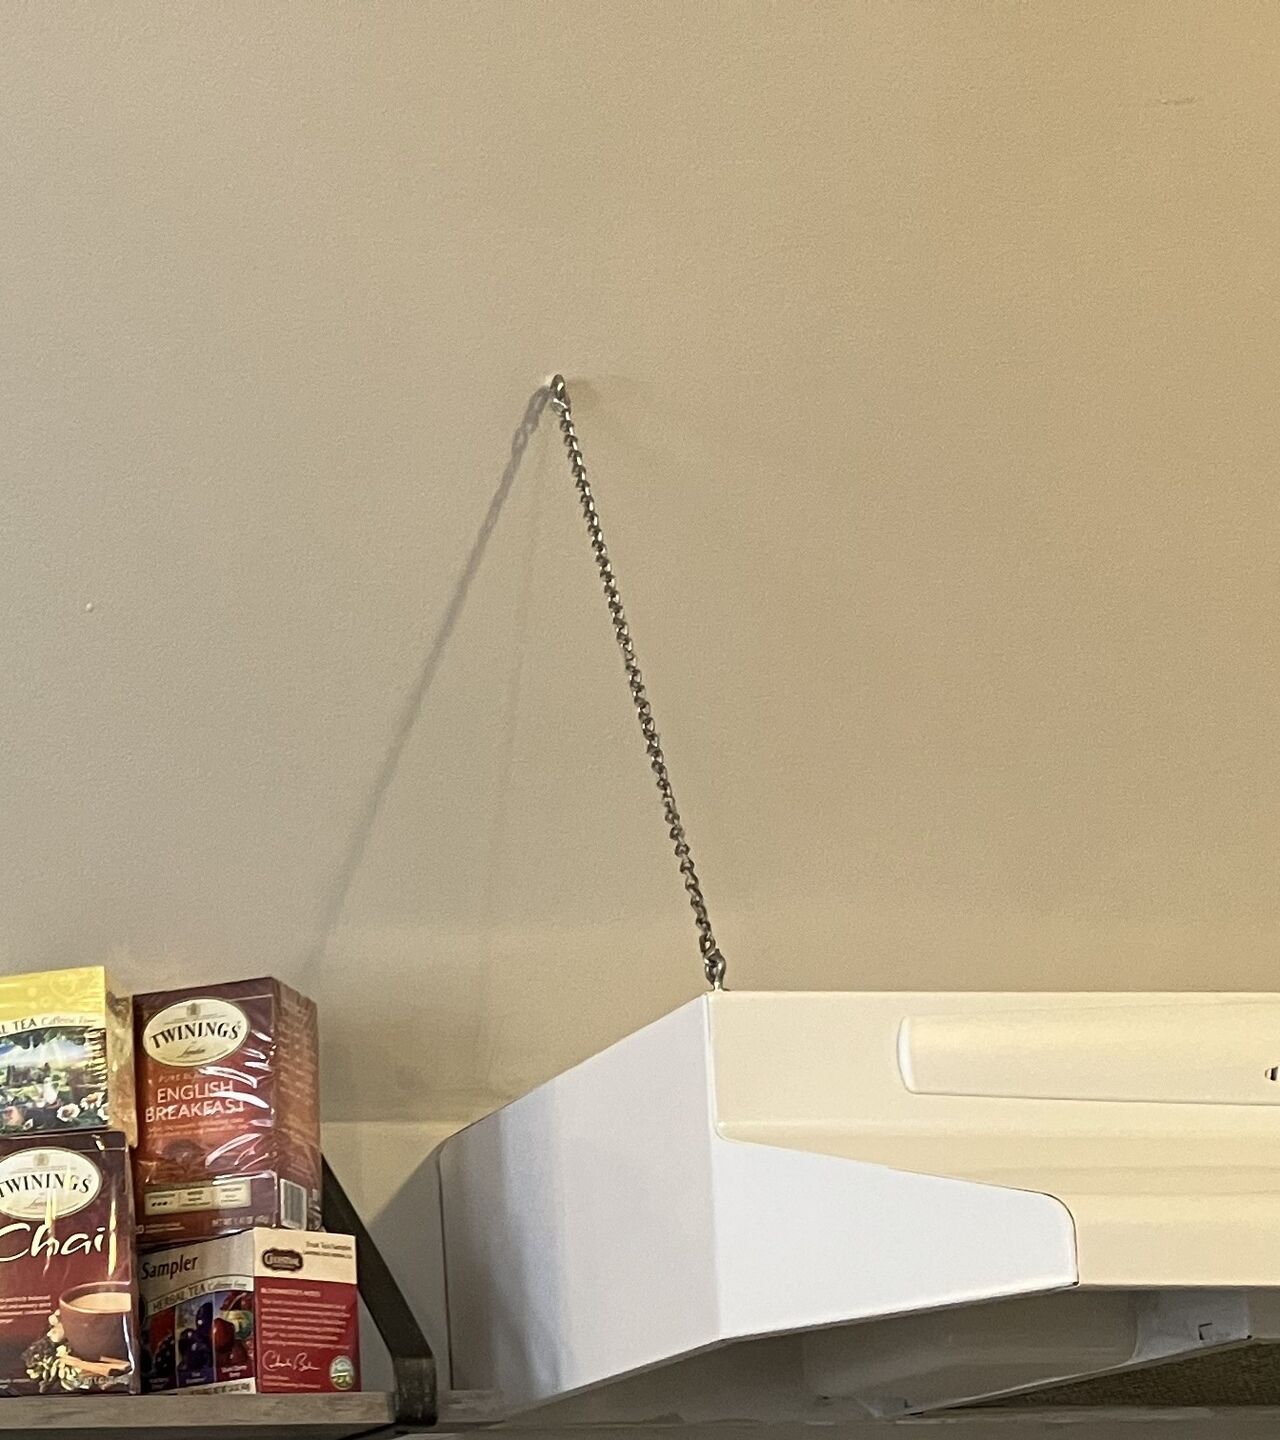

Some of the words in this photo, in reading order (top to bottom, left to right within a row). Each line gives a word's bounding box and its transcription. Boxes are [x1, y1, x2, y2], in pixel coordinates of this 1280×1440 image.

[13, 1018, 38, 1032] TEA
[149, 1020, 240, 1049] TWININGS
[157, 1079, 234, 1104] ENGLISH
[141, 1254, 199, 1281] Sampler
[187, 1283, 207, 1298] TEA
